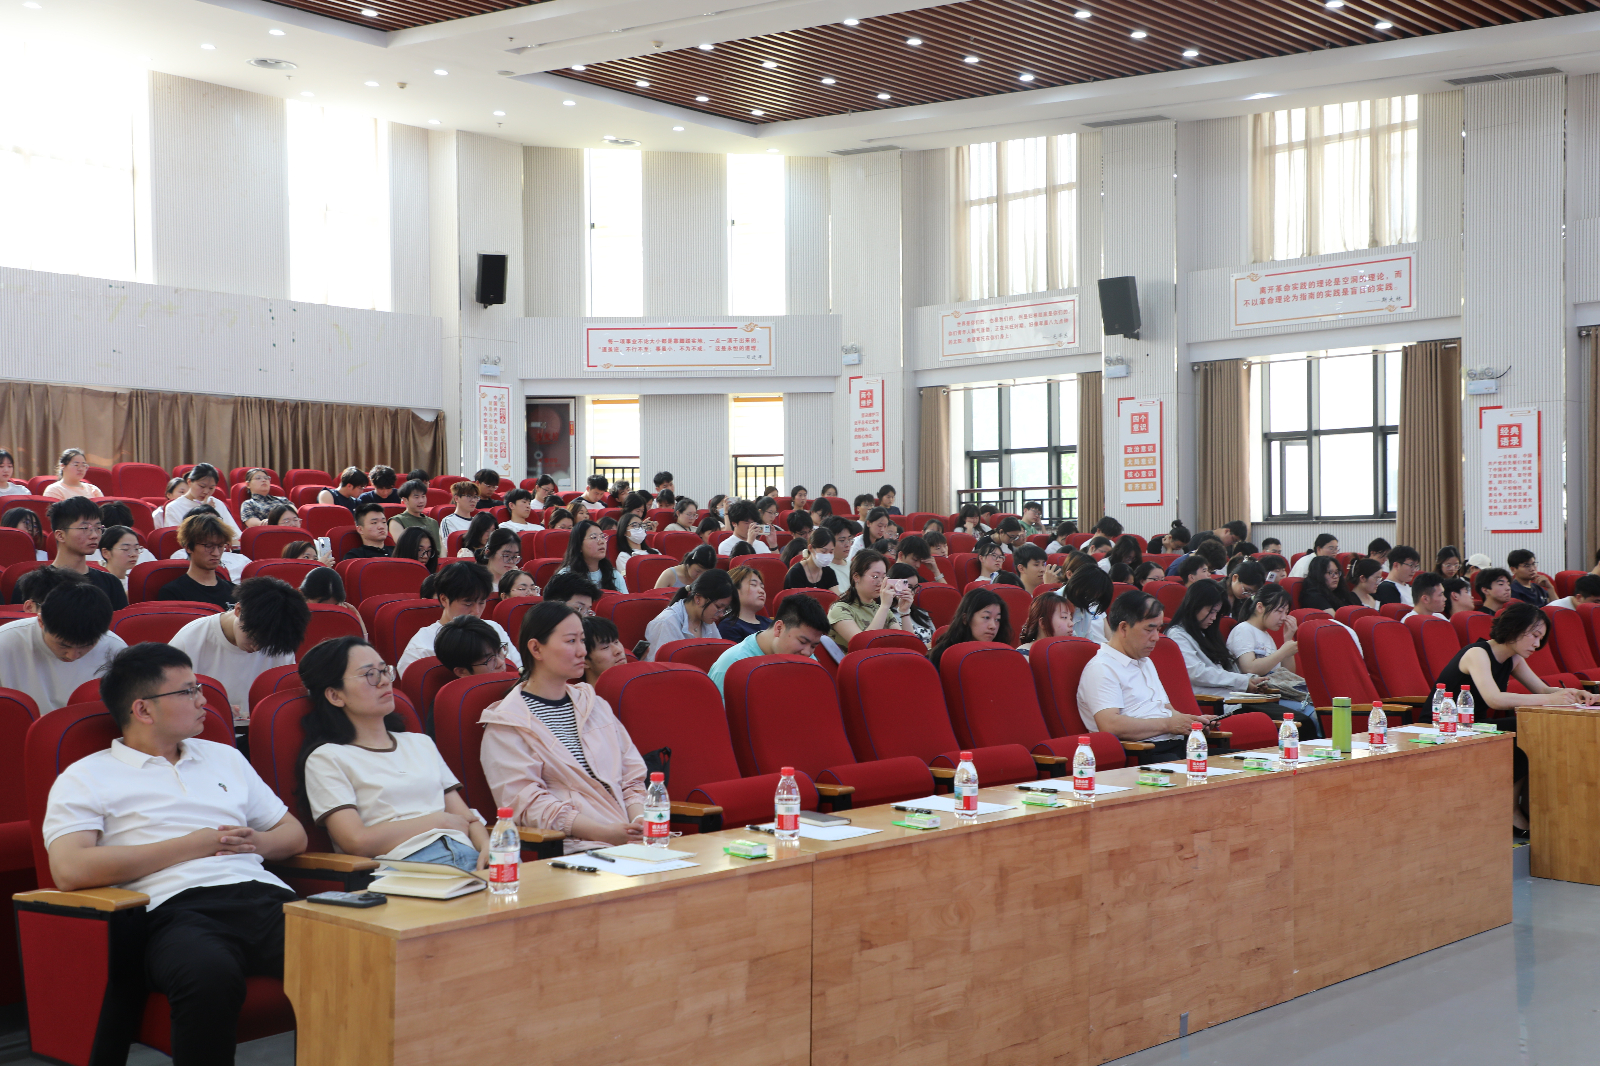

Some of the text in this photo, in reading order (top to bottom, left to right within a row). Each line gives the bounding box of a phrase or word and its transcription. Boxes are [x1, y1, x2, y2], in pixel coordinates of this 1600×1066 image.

[1133, 415, 1147, 423] 四个
[1132, 423, 1147, 432] 意识
[1499, 425, 1520, 436] 经典
[1499, 436, 1520, 446] 语录
[1126, 445, 1154, 453] 政治意识
[1126, 458, 1154, 466] 大局意识
[1126, 470, 1154, 478] 核心意识
